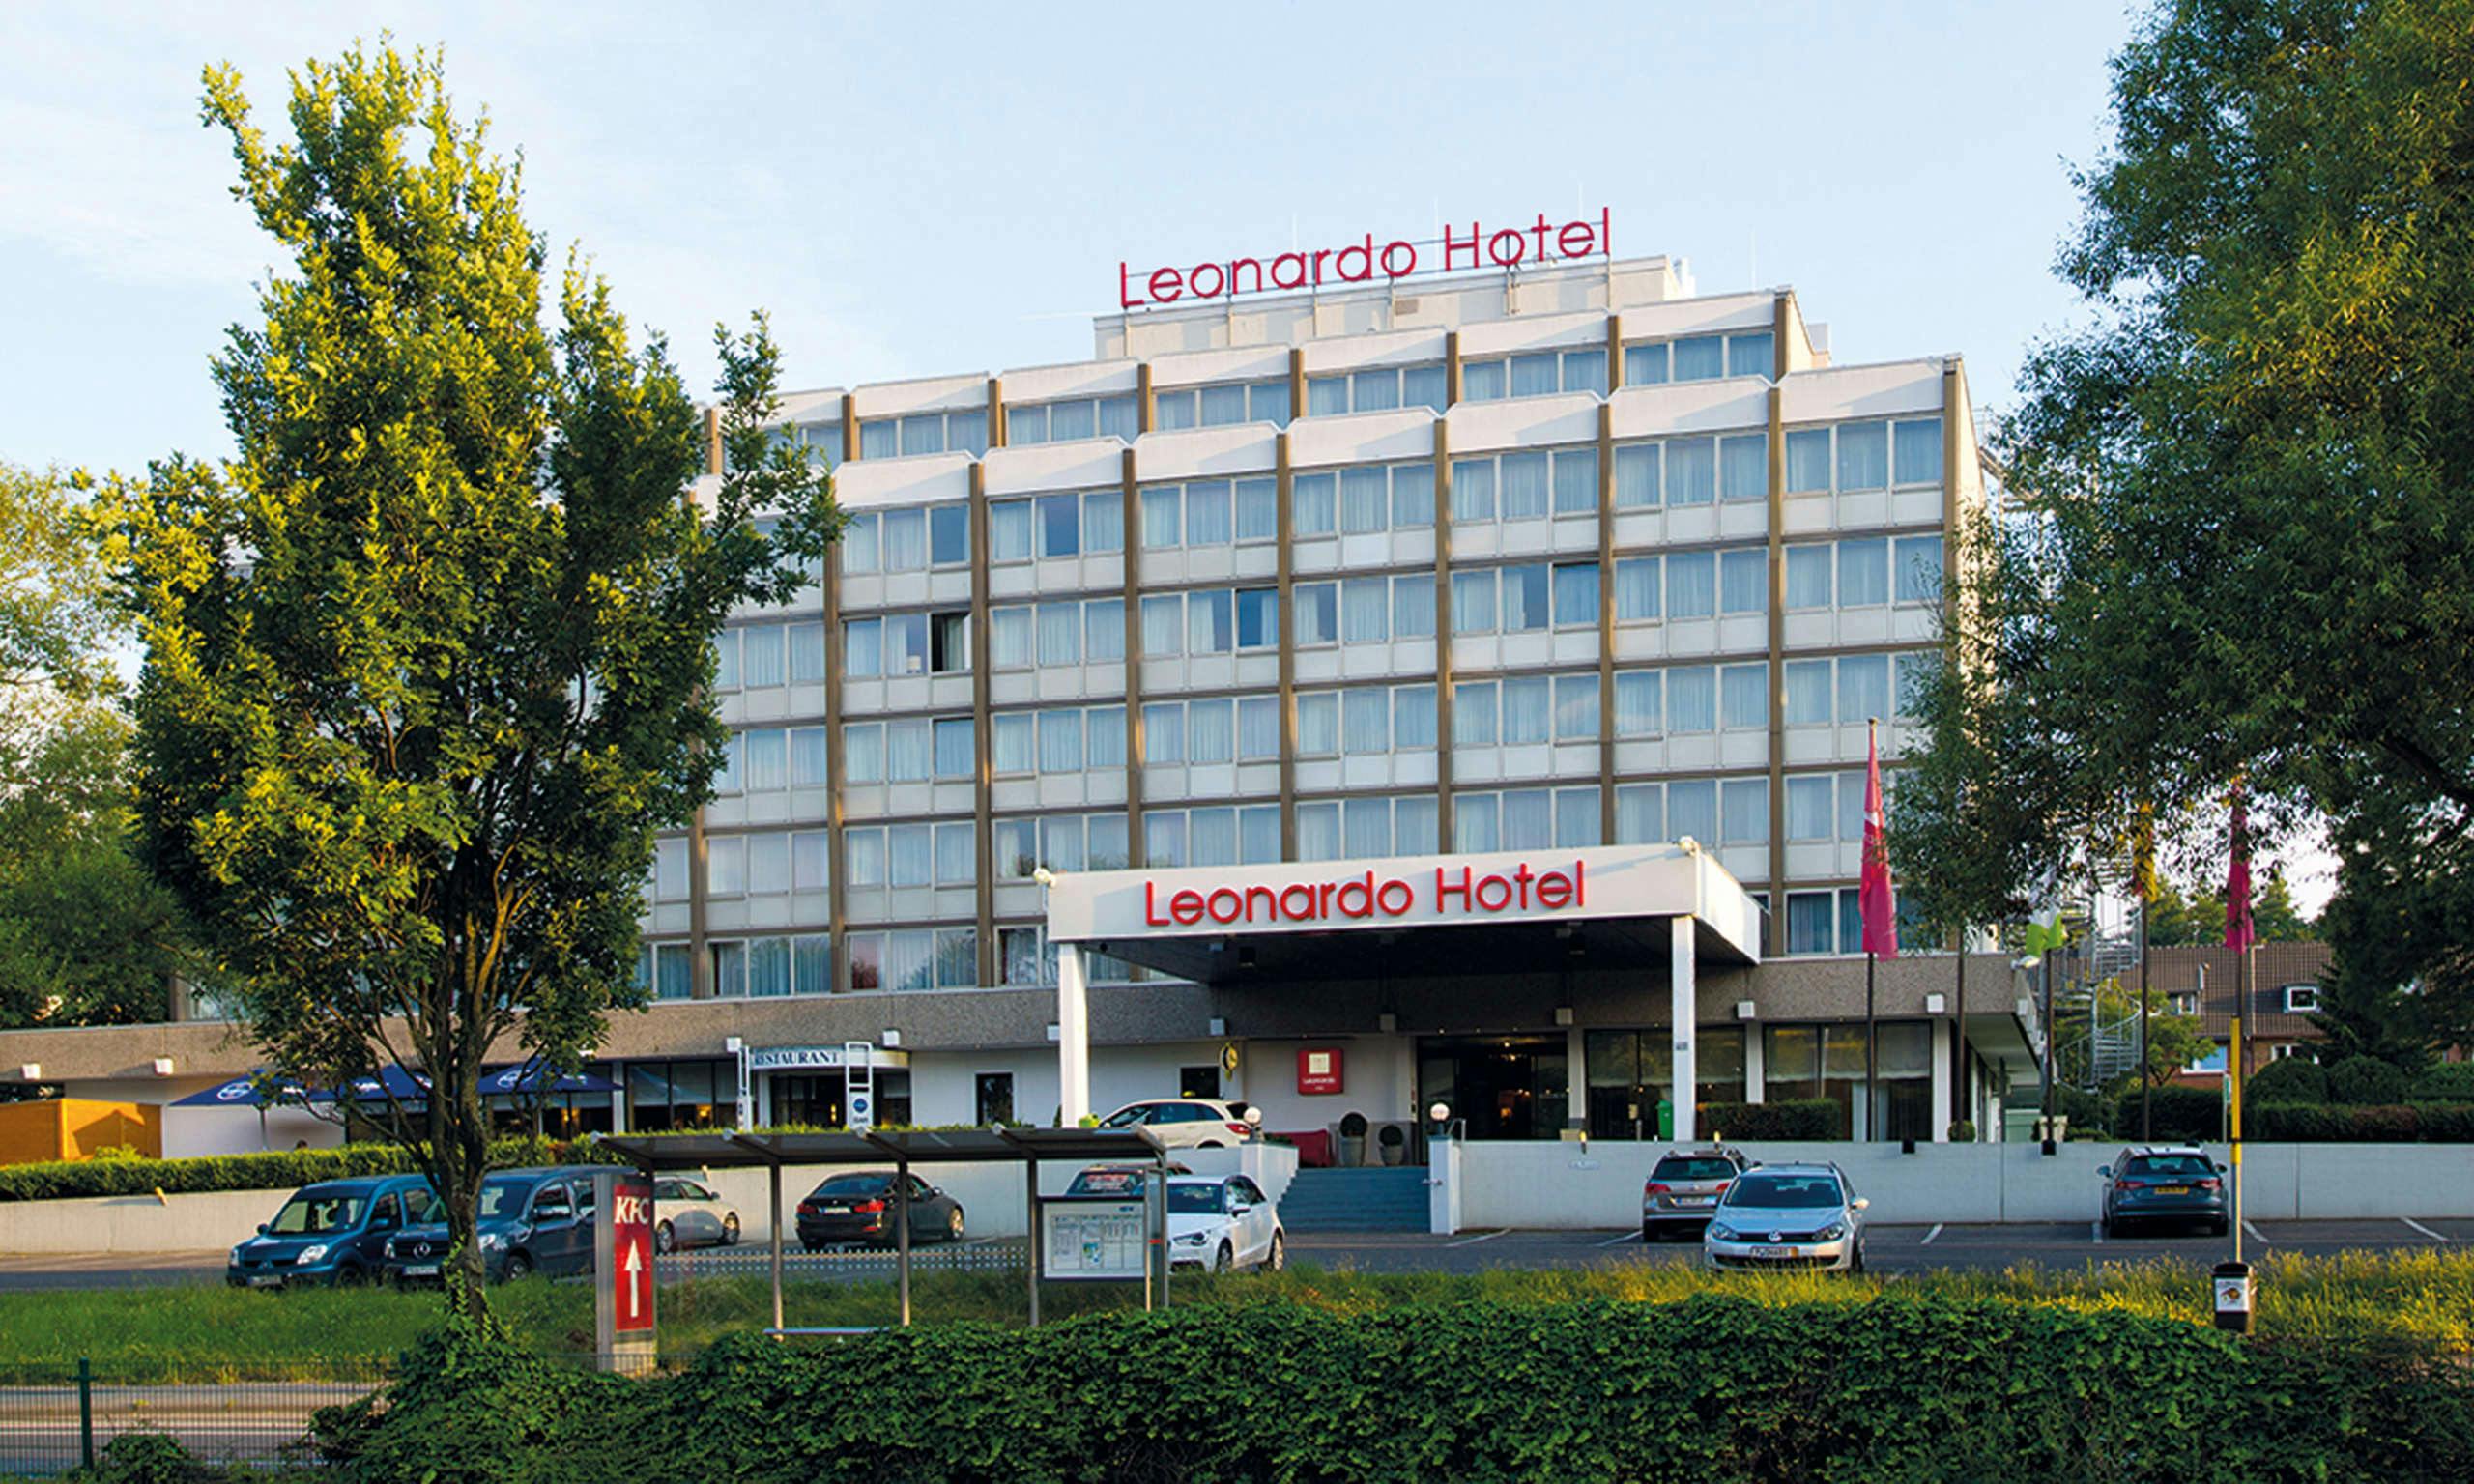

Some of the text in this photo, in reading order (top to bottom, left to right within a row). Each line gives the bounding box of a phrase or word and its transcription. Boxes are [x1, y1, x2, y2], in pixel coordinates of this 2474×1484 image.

[1120, 207, 1610, 308] Leonardo Hotel
[1145, 859, 1586, 927] Leonardo Hotel
[614, 1195, 649, 1225] KFC
